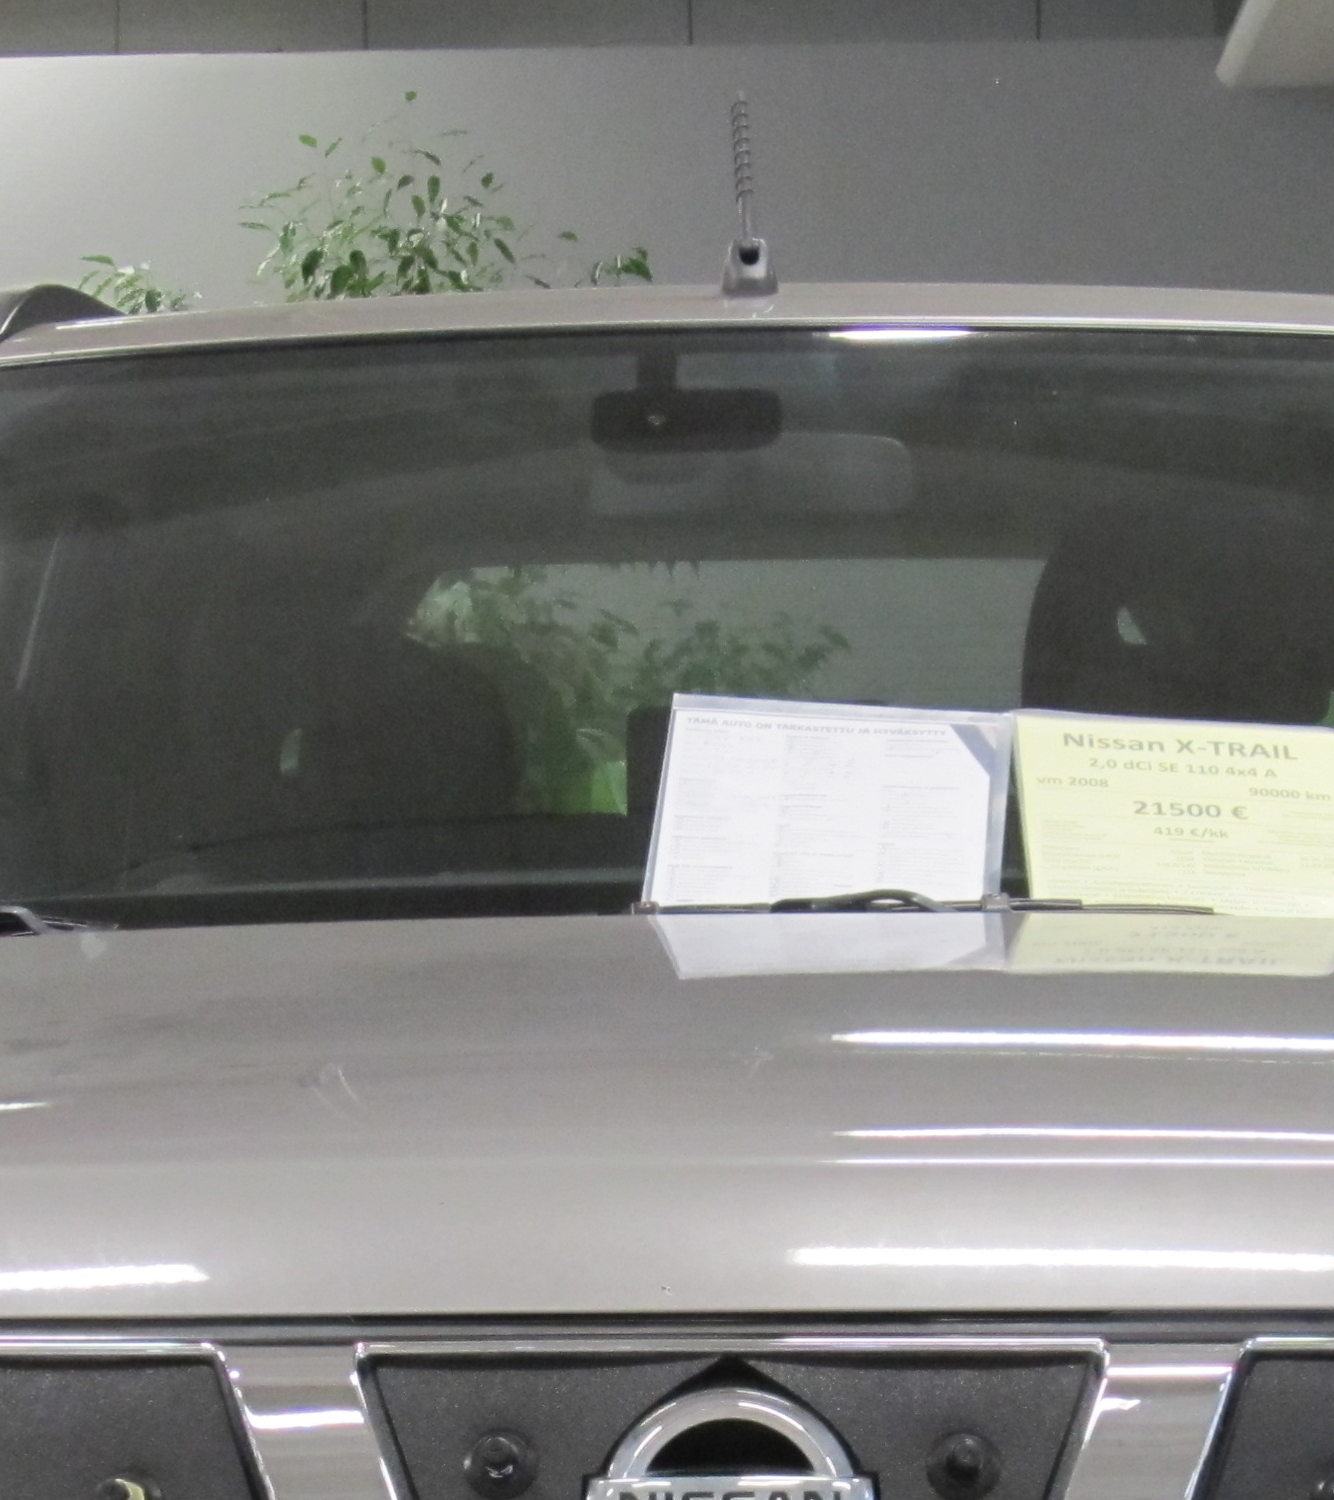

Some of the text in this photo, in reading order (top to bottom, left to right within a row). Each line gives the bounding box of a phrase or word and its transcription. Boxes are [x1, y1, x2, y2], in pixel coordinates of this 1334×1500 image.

[722, 719, 752, 729] AUTO
[755, 722, 772, 730] ON
[776, 723, 854, 734] TARKASTETTU
[858, 727, 870, 735] JA
[1062, 732, 1299, 761] Nissan X-TRAIL
[1089, 757, 1278, 779] 2,0 dCi SE 110 4x4 A
[1036, 776, 1109, 788] vm 2008
[1248, 787, 1332, 802] 90000 km
[1133, 800, 1249, 820] 21500 €
[1153, 826, 1230, 840] 419 €/kk
